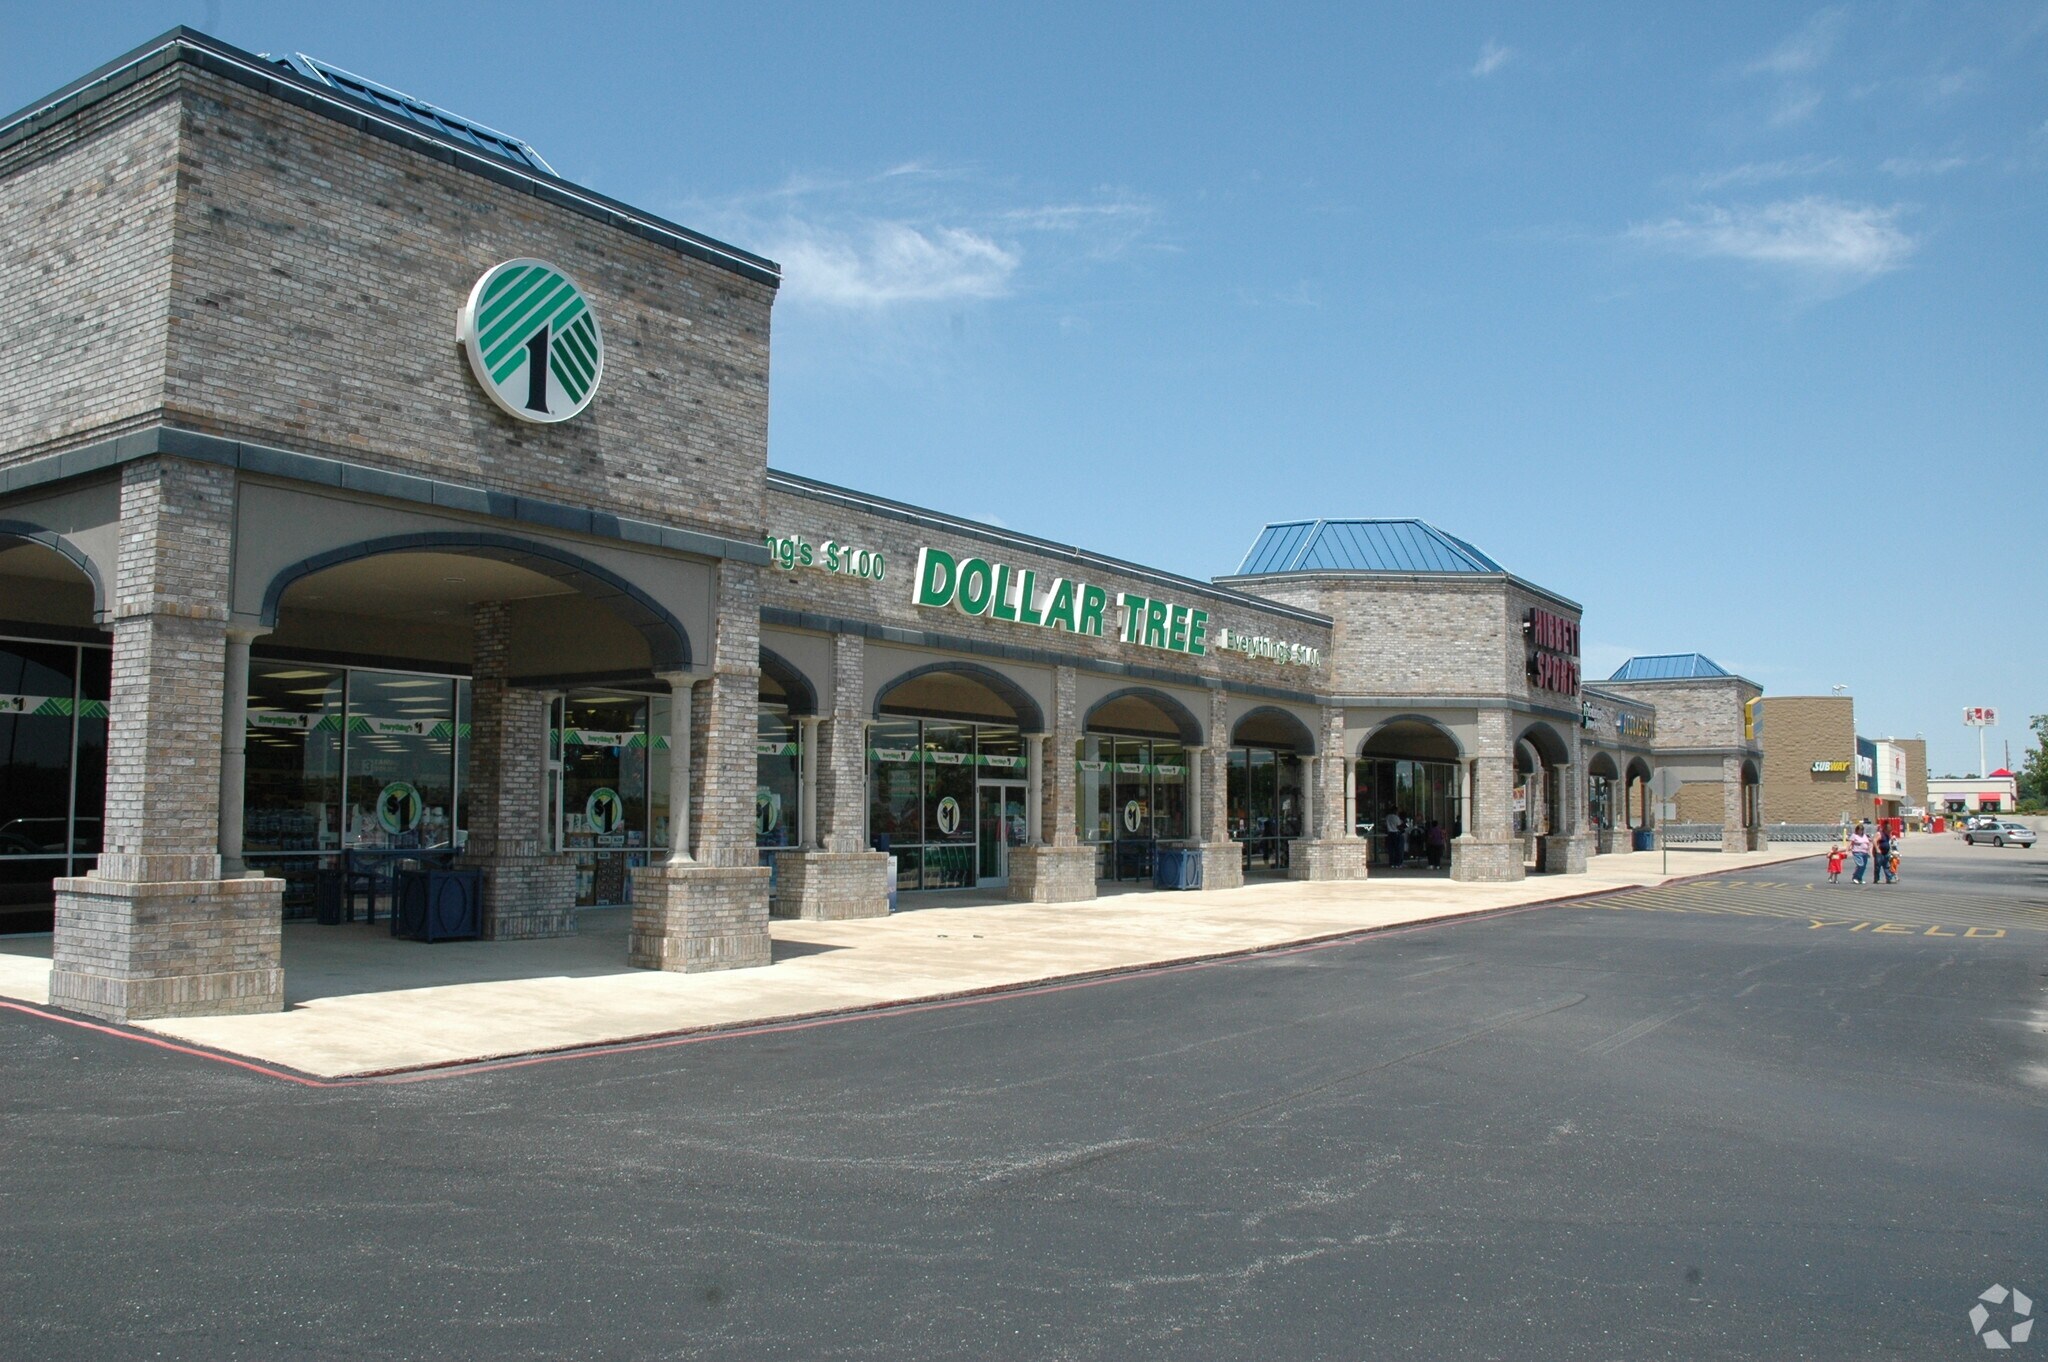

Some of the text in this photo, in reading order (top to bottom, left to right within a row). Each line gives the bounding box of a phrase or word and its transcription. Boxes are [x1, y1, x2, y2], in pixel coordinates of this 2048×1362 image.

[822, 540, 886, 580] $1.00
[912, 546, 1209, 656] DOLLAR TREE
[1530, 608, 1580, 657] HIBBETT
[1535, 651, 1580, 697] SPORTS
[1812, 761, 1850, 772] SUBWAY
[1807, 919, 2006, 938] YIELD
